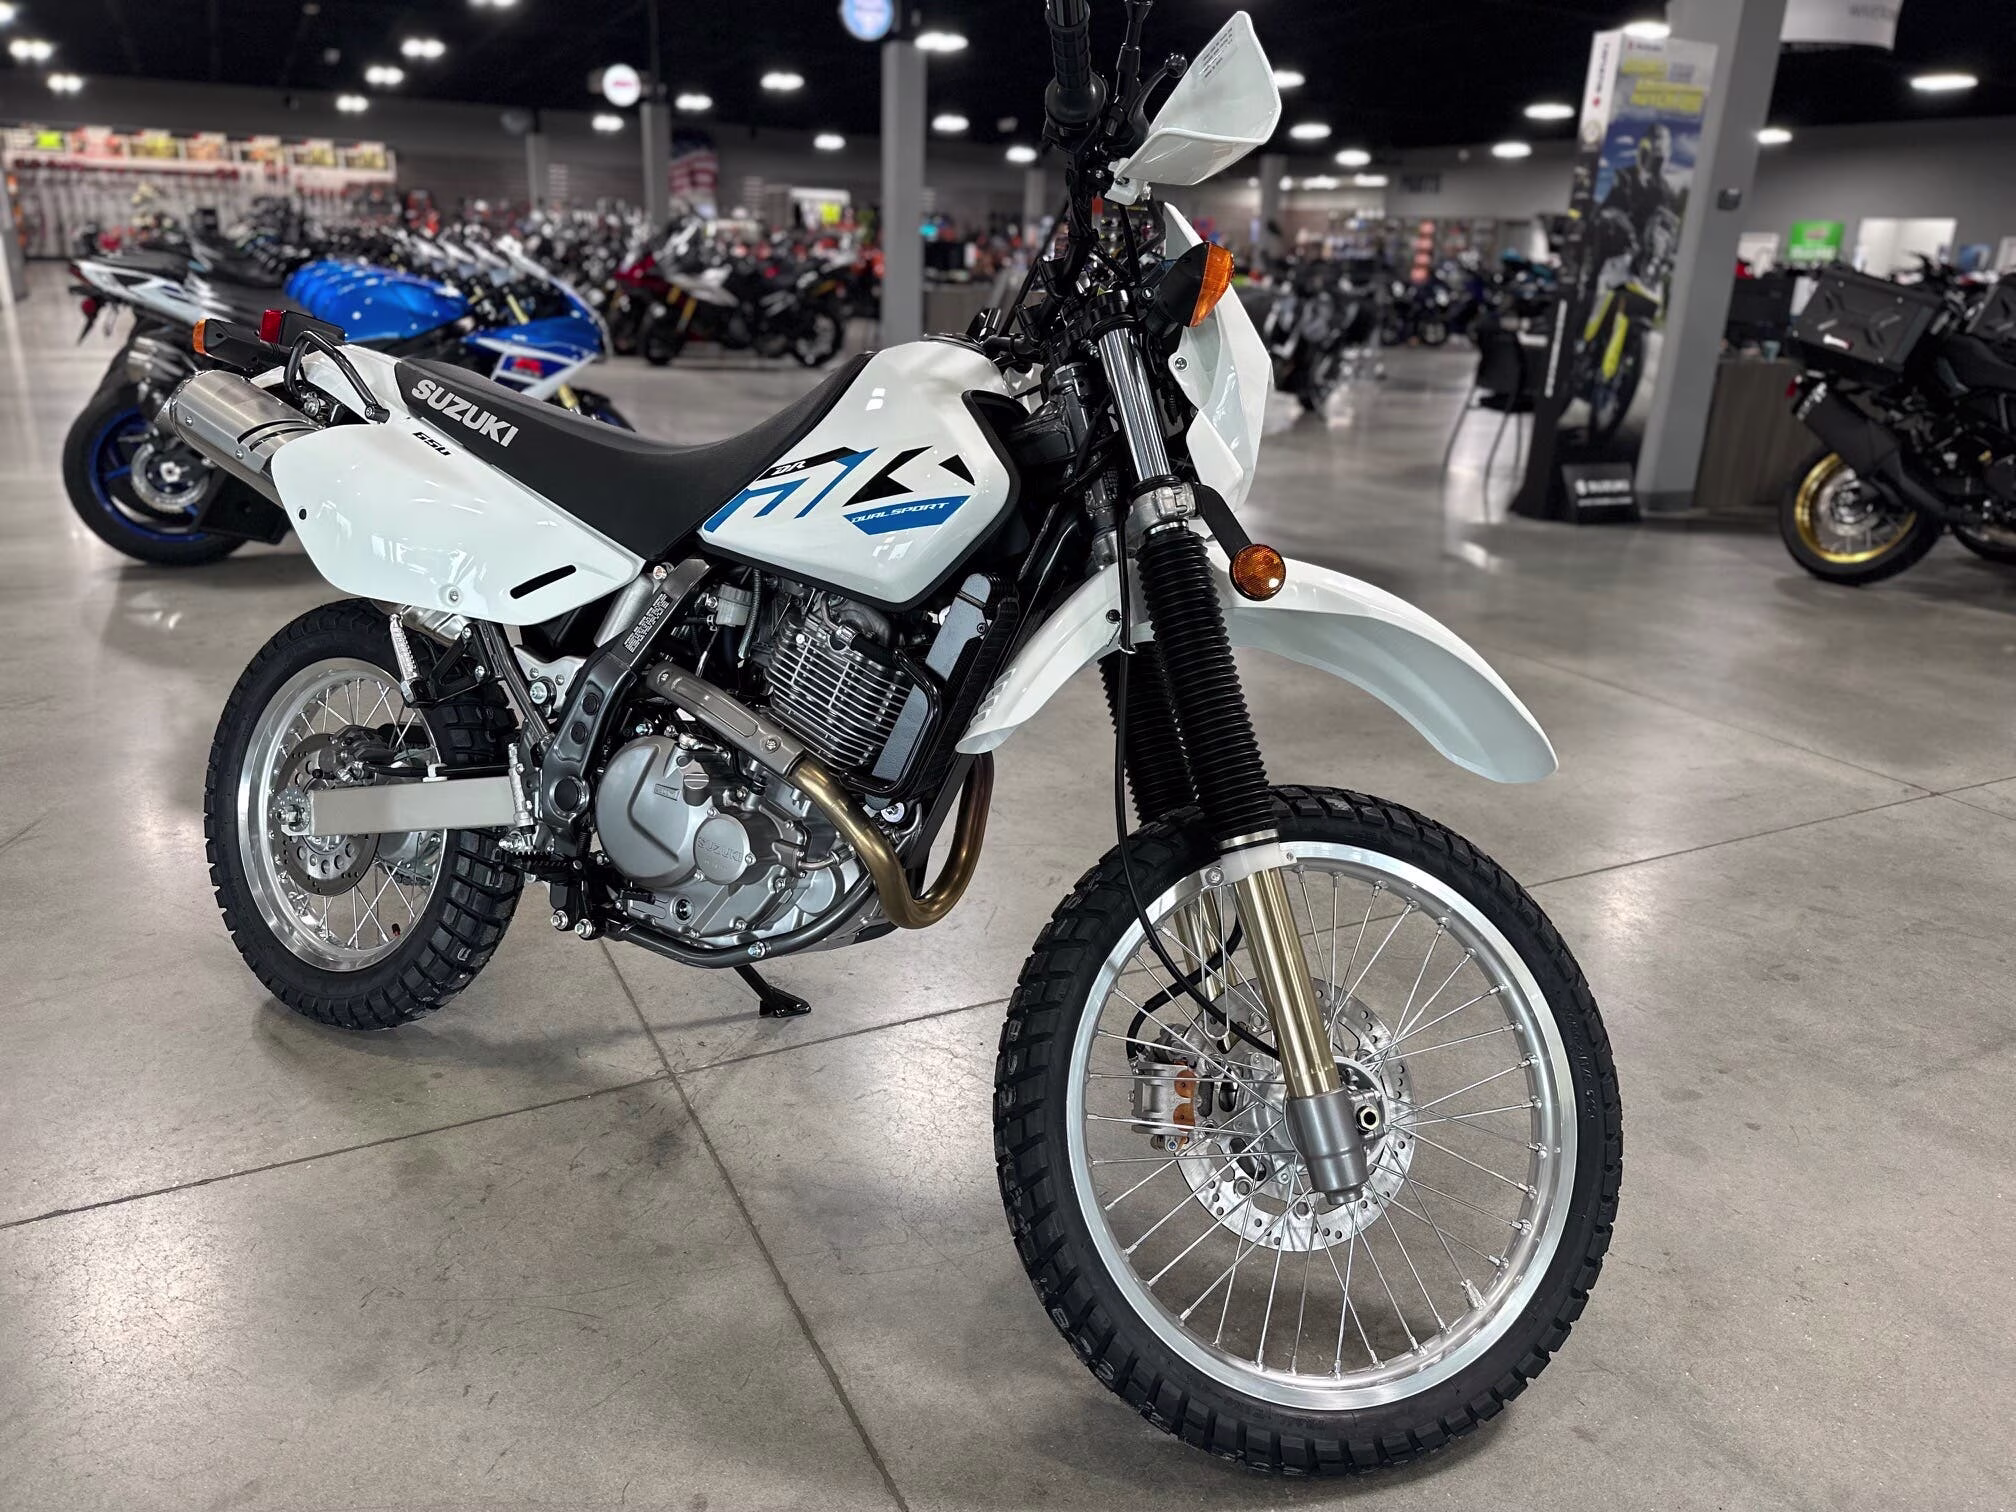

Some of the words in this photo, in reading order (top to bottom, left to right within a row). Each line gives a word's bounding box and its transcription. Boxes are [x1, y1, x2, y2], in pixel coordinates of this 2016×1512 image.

[411, 379, 519, 447] SUZUKI
[770, 460, 806, 476] DR
[851, 511, 890, 523] DUAL
[890, 502, 949, 516] SPORT
[696, 837, 743, 863] SUZUKI
